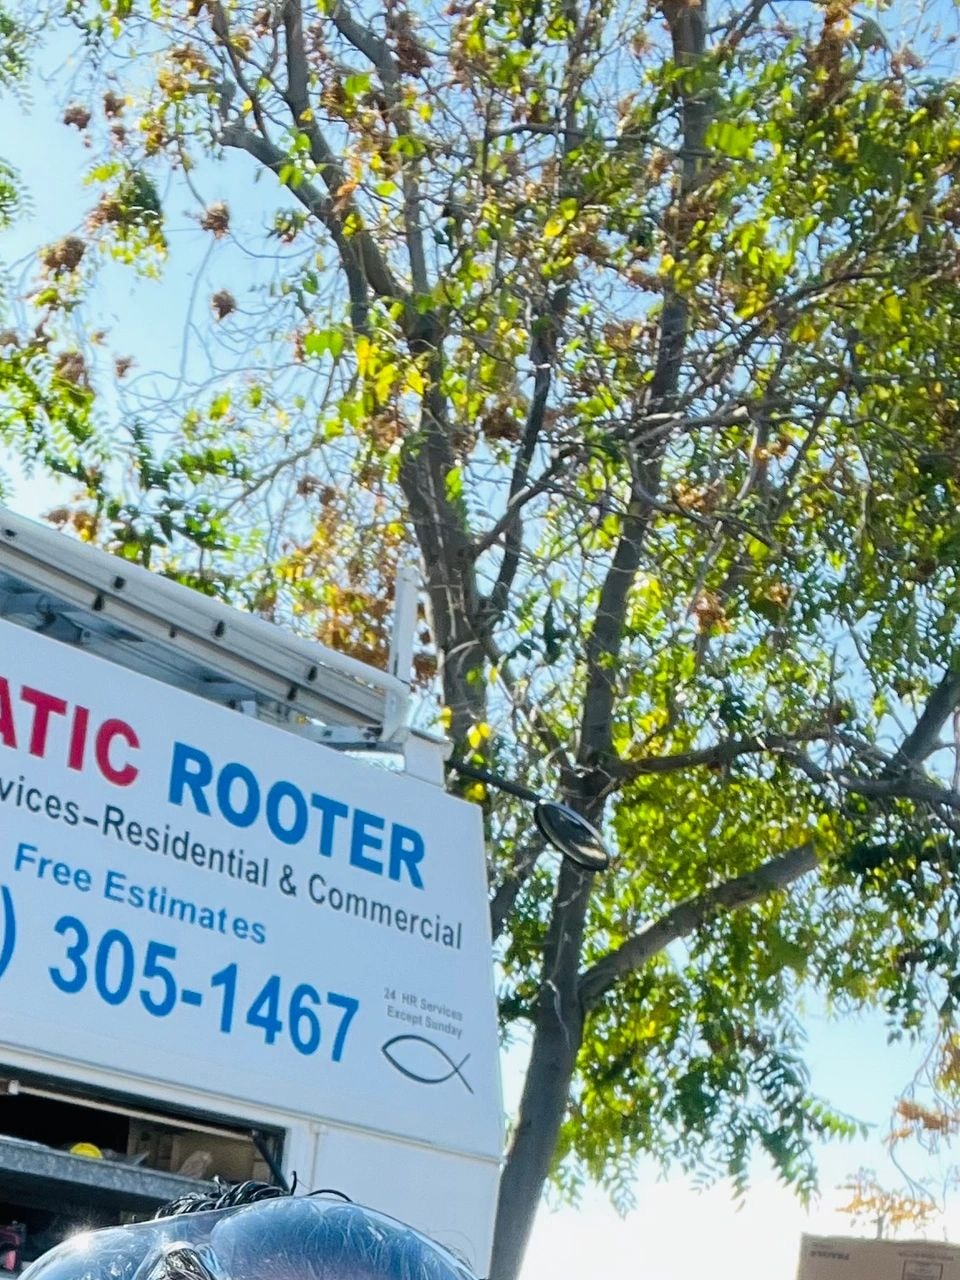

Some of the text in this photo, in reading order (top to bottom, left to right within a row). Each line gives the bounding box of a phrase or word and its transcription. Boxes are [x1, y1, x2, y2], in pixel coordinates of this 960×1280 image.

[167, 741, 425, 890] ROOTER
[14, 842, 267, 945] Free Estimates
[279, 865, 298, 896] &
[308, 874, 463, 951] Commercial
[48, 915, 360, 1062] 305-1467
[383, 987, 463, 1022] 24 HR Services
[387, 1005, 463, 1040] Except Sunday
